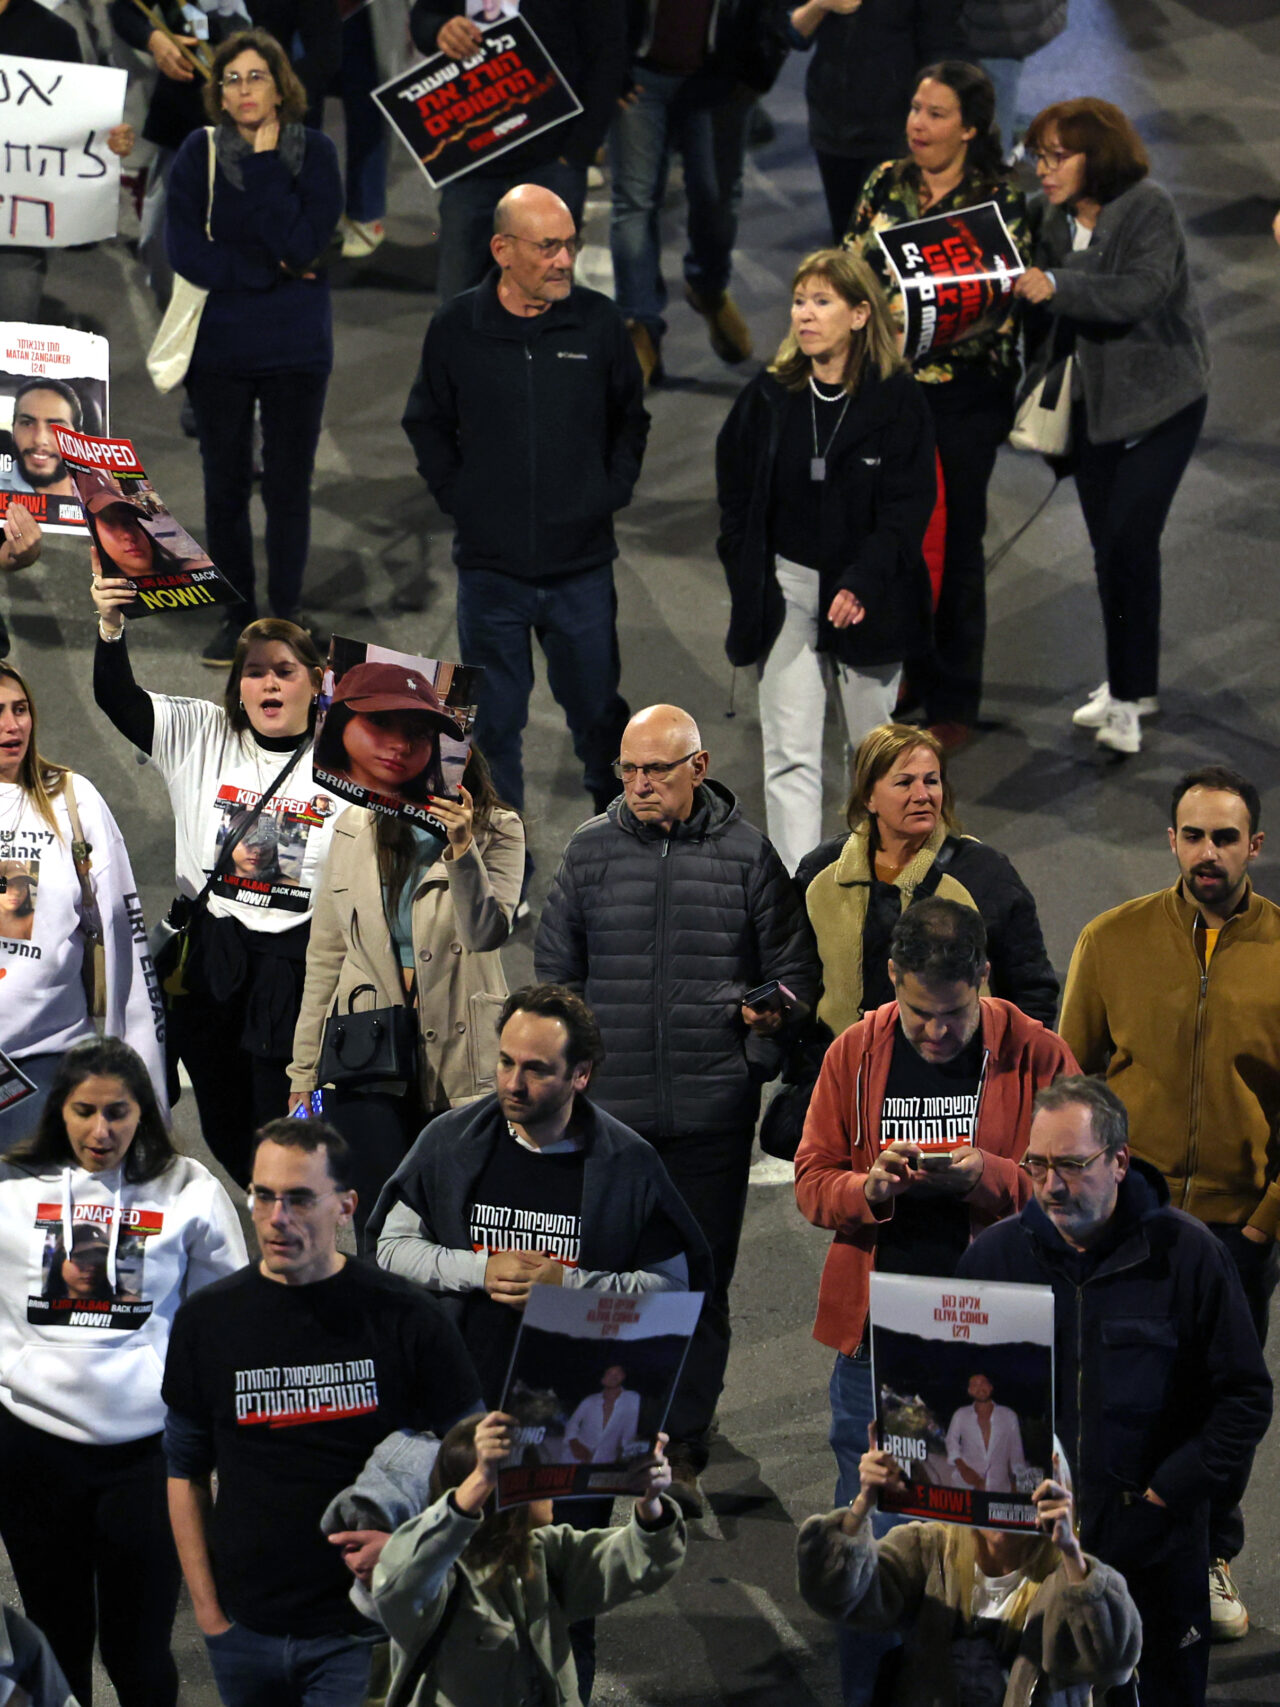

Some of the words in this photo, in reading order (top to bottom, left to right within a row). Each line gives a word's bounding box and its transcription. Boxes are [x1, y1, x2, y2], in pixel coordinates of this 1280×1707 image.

[486, 34, 517, 54] כל
[398, 63, 460, 103] שעובר
[461, 51, 523, 91] הורג
[416, 82, 462, 119] את
[423, 67, 537, 137] החטופים
[901, 242, 924, 269] כל
[914, 271, 937, 301] ים
[6, 349, 30, 361] MATAN
[31, 351, 72, 365] ZANGAUKER
[56, 430, 137, 467] KIDNAPPED
[191, 570, 219, 582] BACK
[138, 585, 216, 610] NOW!!
[315, 769, 366, 798] BRING
[236, 789, 307, 814] KIDAPPED
[366, 801, 399, 818] NOW!
[22, 830, 55, 845] לירי
[235, 889, 272, 907] NOW!!
[240, 879, 271, 893] ALBAG
[271, 886, 290, 896] BACK
[289, 888, 310, 899] HOME
[123, 892, 148, 945] LIRI
[882, 1097, 920, 1118] להחזר
[74, 1205, 141, 1226] DNAPED
[470, 1203, 512, 1228] להחזר
[512, 1209, 576, 1236] המשפחות
[470, 1225, 533, 1252] והנעדרי
[536, 1234, 581, 1262] טופים
[28, 1299, 50, 1309] BRING
[74, 1300, 111, 1311] ALBAG
[111, 1304, 133, 1313] BACK
[933, 1308, 958, 1322] ELIYA
[959, 1311, 989, 1325] COHEN
[69, 1312, 113, 1327] NOW!!
[235, 1366, 281, 1392] להחזרת
[282, 1363, 345, 1387] המשפחות
[345, 1359, 376, 1381] מטה
[235, 1388, 306, 1420] והנעדרים
[309, 1381, 379, 1413] החטופים
[928, 1487, 972, 1513] NOW!
